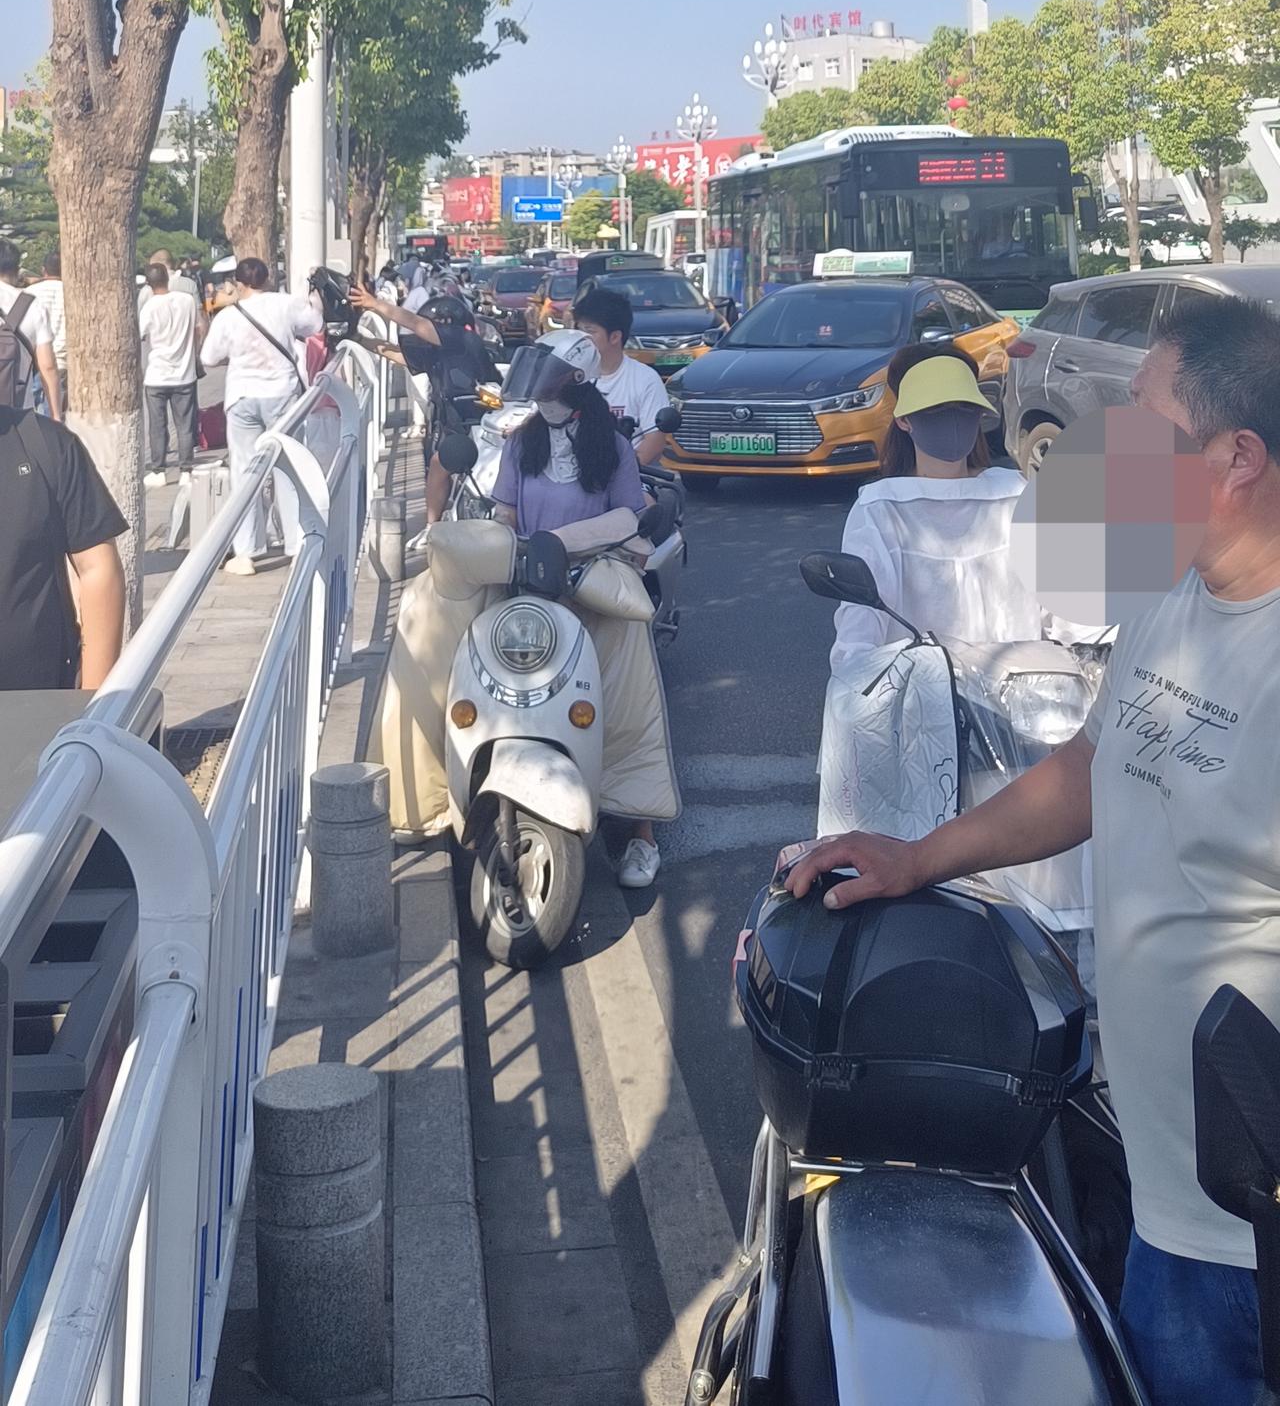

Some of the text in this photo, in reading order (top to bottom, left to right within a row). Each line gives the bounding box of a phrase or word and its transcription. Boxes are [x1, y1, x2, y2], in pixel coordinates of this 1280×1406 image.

[793, 9, 862, 31] 时代宾馆
[1133, 666, 1156, 684] HIS'S
[1155, 676, 1162, 687] A
[1201, 700, 1239, 724] WORLD
[1168, 708, 1229, 773] Time
[1124, 762, 1163, 788] SUMME
